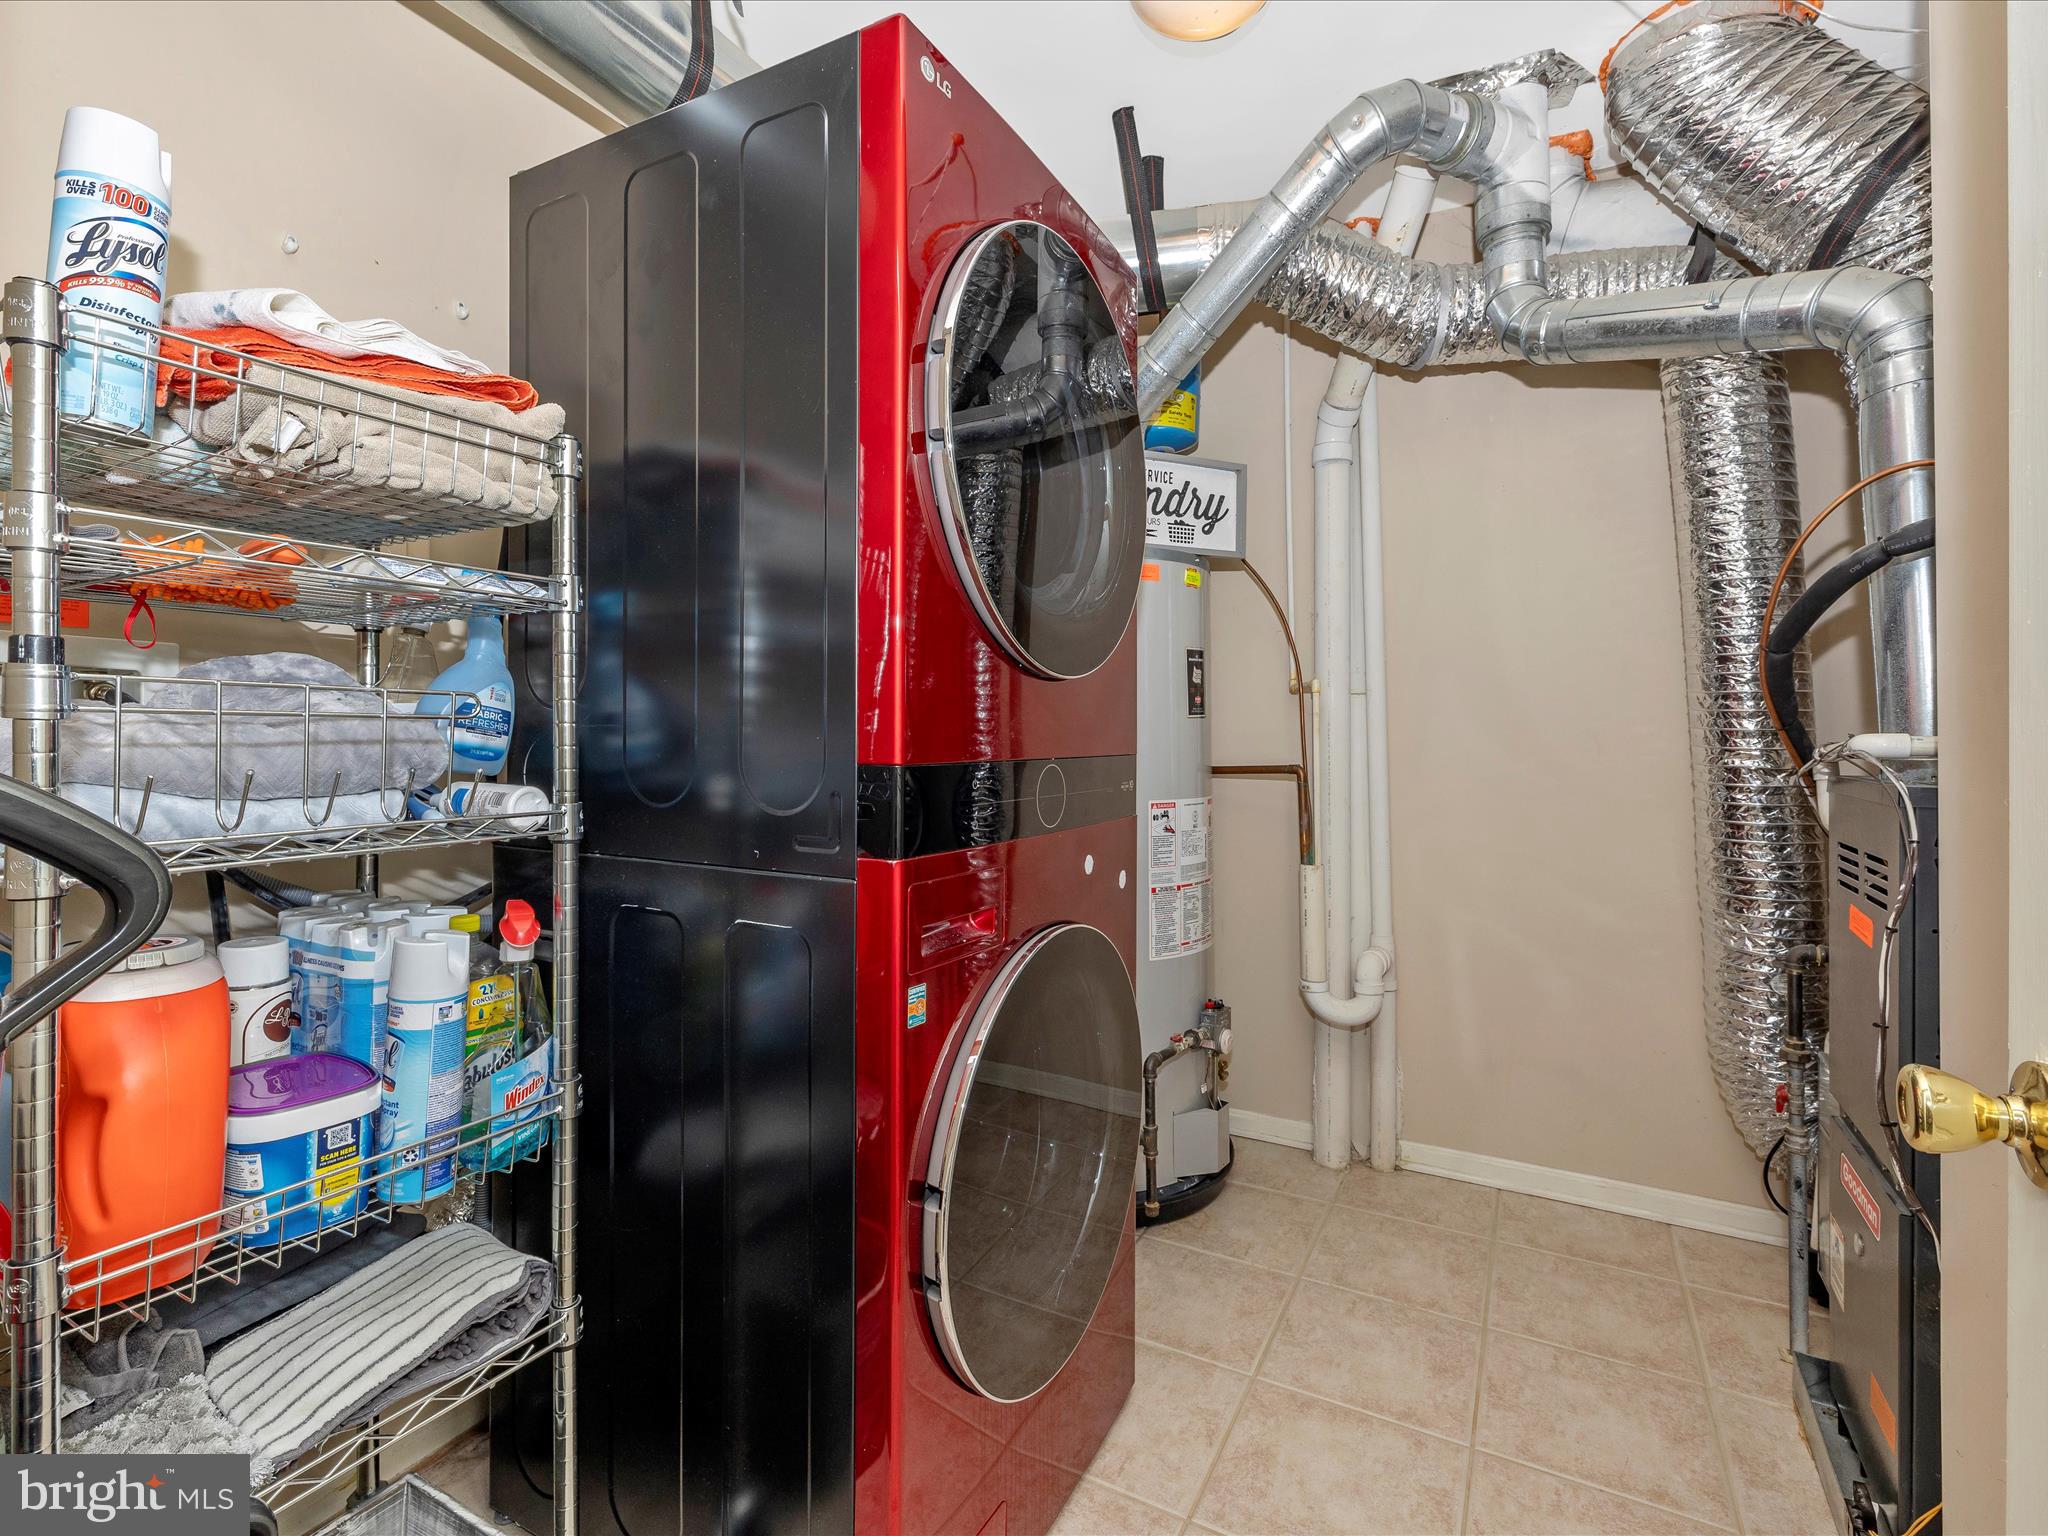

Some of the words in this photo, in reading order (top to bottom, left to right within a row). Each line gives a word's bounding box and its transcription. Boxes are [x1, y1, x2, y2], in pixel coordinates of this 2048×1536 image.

[937, 72, 951, 100] LG
[66, 179, 96, 189] KILLS
[67, 187, 96, 196] OVER
[99, 182, 152, 217] 100
[65, 222, 165, 273] Lysol
[67, 279, 88, 288] KILLS
[89, 276, 125, 288] 99.9%
[115, 354, 138, 368] Crisp
[505, 1075, 545, 1111] Windex
[320, 1150, 340, 1163] SCAN
[340, 1145, 357, 1156] HERE
[1842, 1163, 1878, 1229] Goodman
